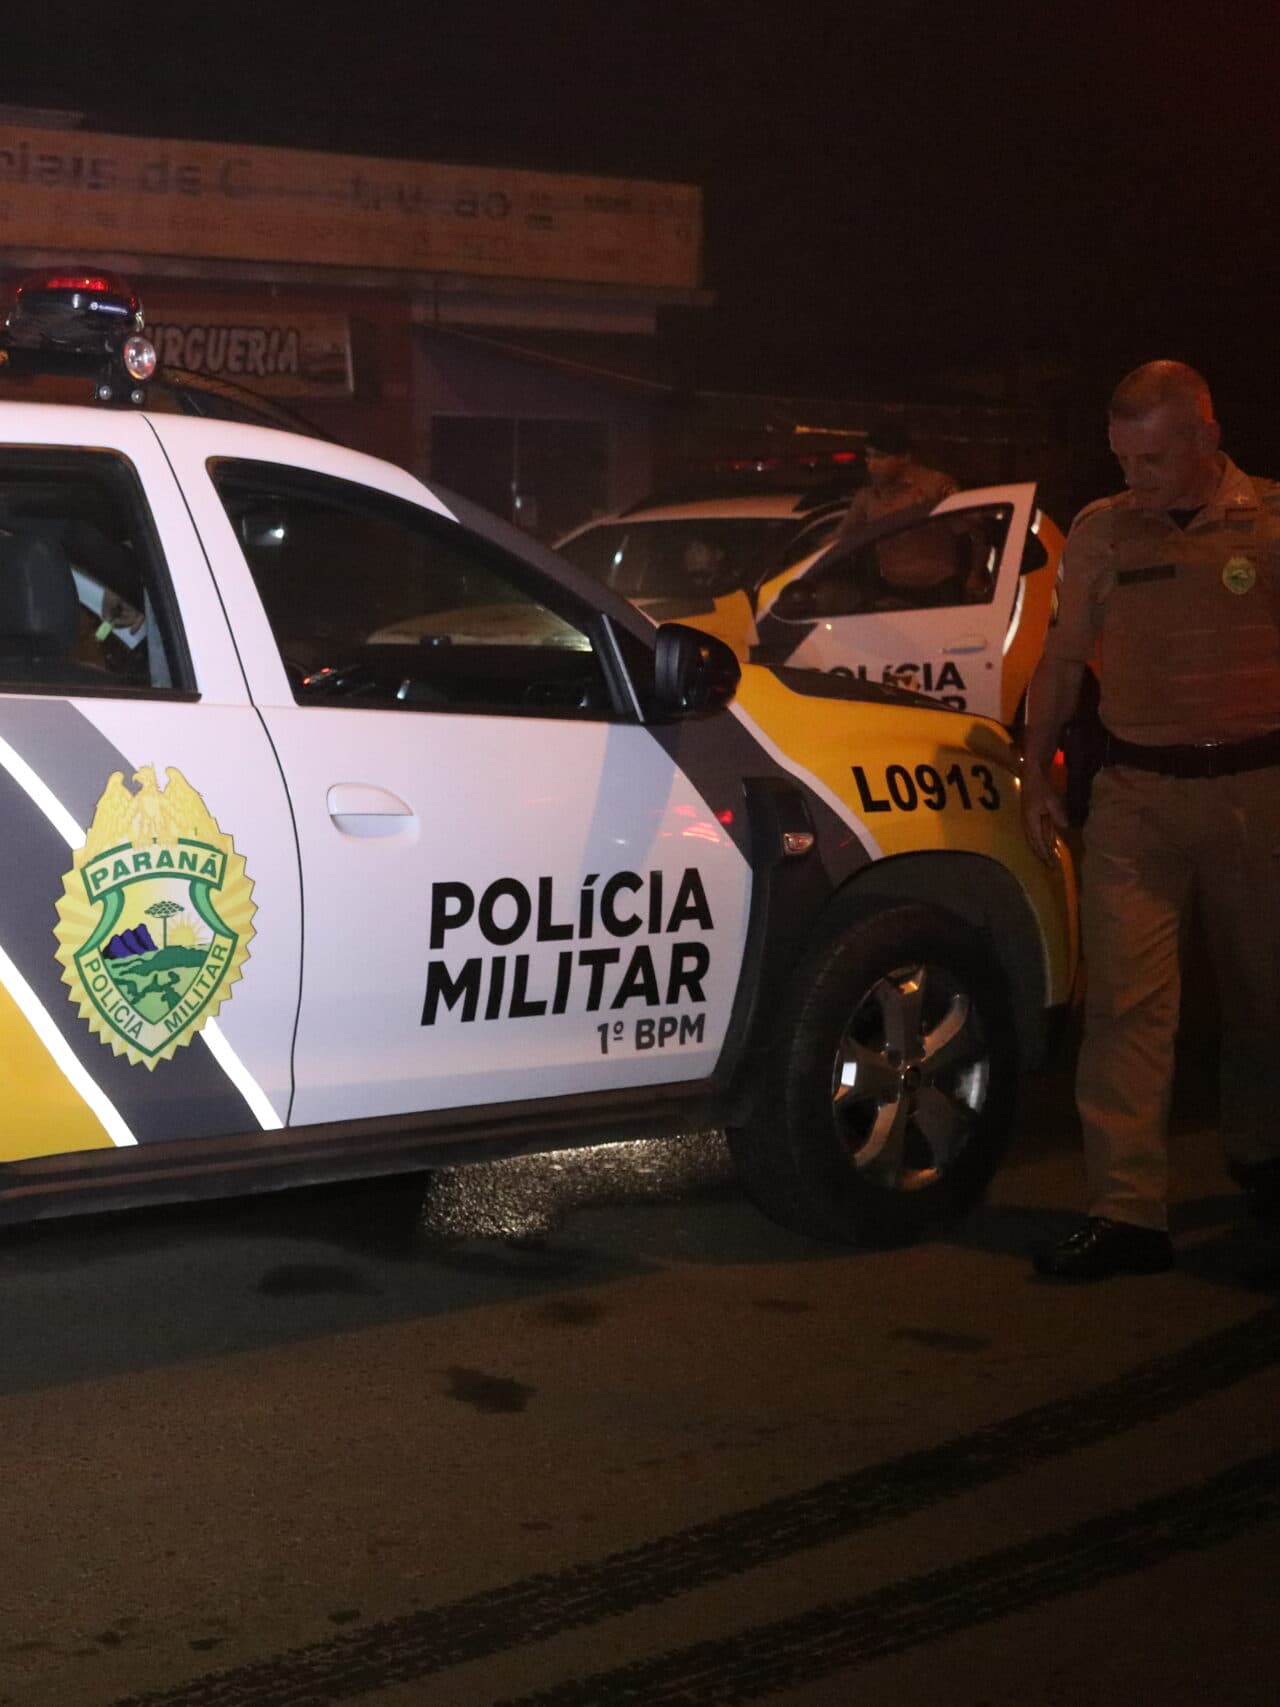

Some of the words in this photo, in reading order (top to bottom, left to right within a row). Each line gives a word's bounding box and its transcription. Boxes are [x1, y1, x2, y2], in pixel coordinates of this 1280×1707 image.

[851, 764, 1001, 812] L0913
[89, 849, 218, 891] PARANÁ
[83, 957, 144, 1039] POLÍCIA
[163, 944, 229, 1034] MILITAR
[421, 941, 710, 1026] MILITAR
[635, 1013, 707, 1051] BPM
